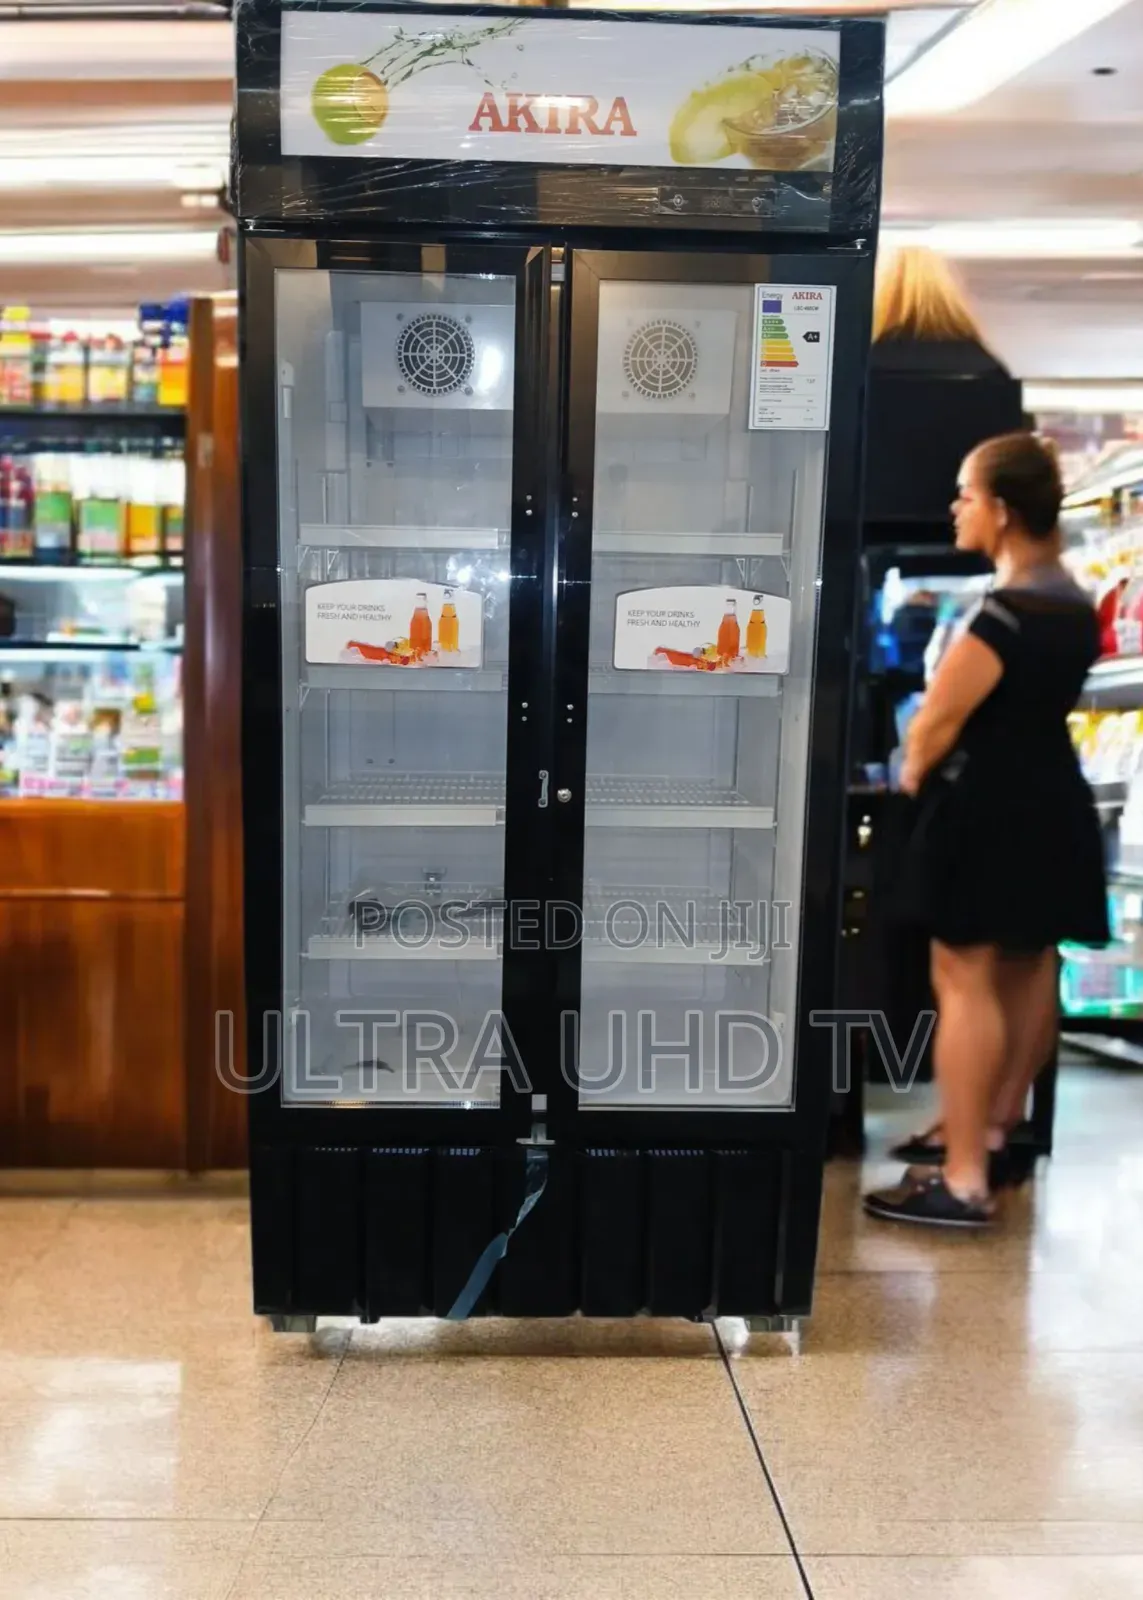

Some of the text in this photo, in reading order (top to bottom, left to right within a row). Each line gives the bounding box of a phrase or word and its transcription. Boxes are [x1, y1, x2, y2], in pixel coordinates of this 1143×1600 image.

[468, 92, 637, 136] AKIRA
[762, 291, 783, 300] Energy
[792, 291, 823, 300] AKIRA
[317, 603, 386, 612] KEEP YOUR DRINKS
[317, 612, 392, 621] FRESH AND HEALTHY
[646, 610, 666, 618] YOUR
[667, 610, 694, 618] DRINKS
[627, 619, 701, 628] FRESH AND HEALTHY
